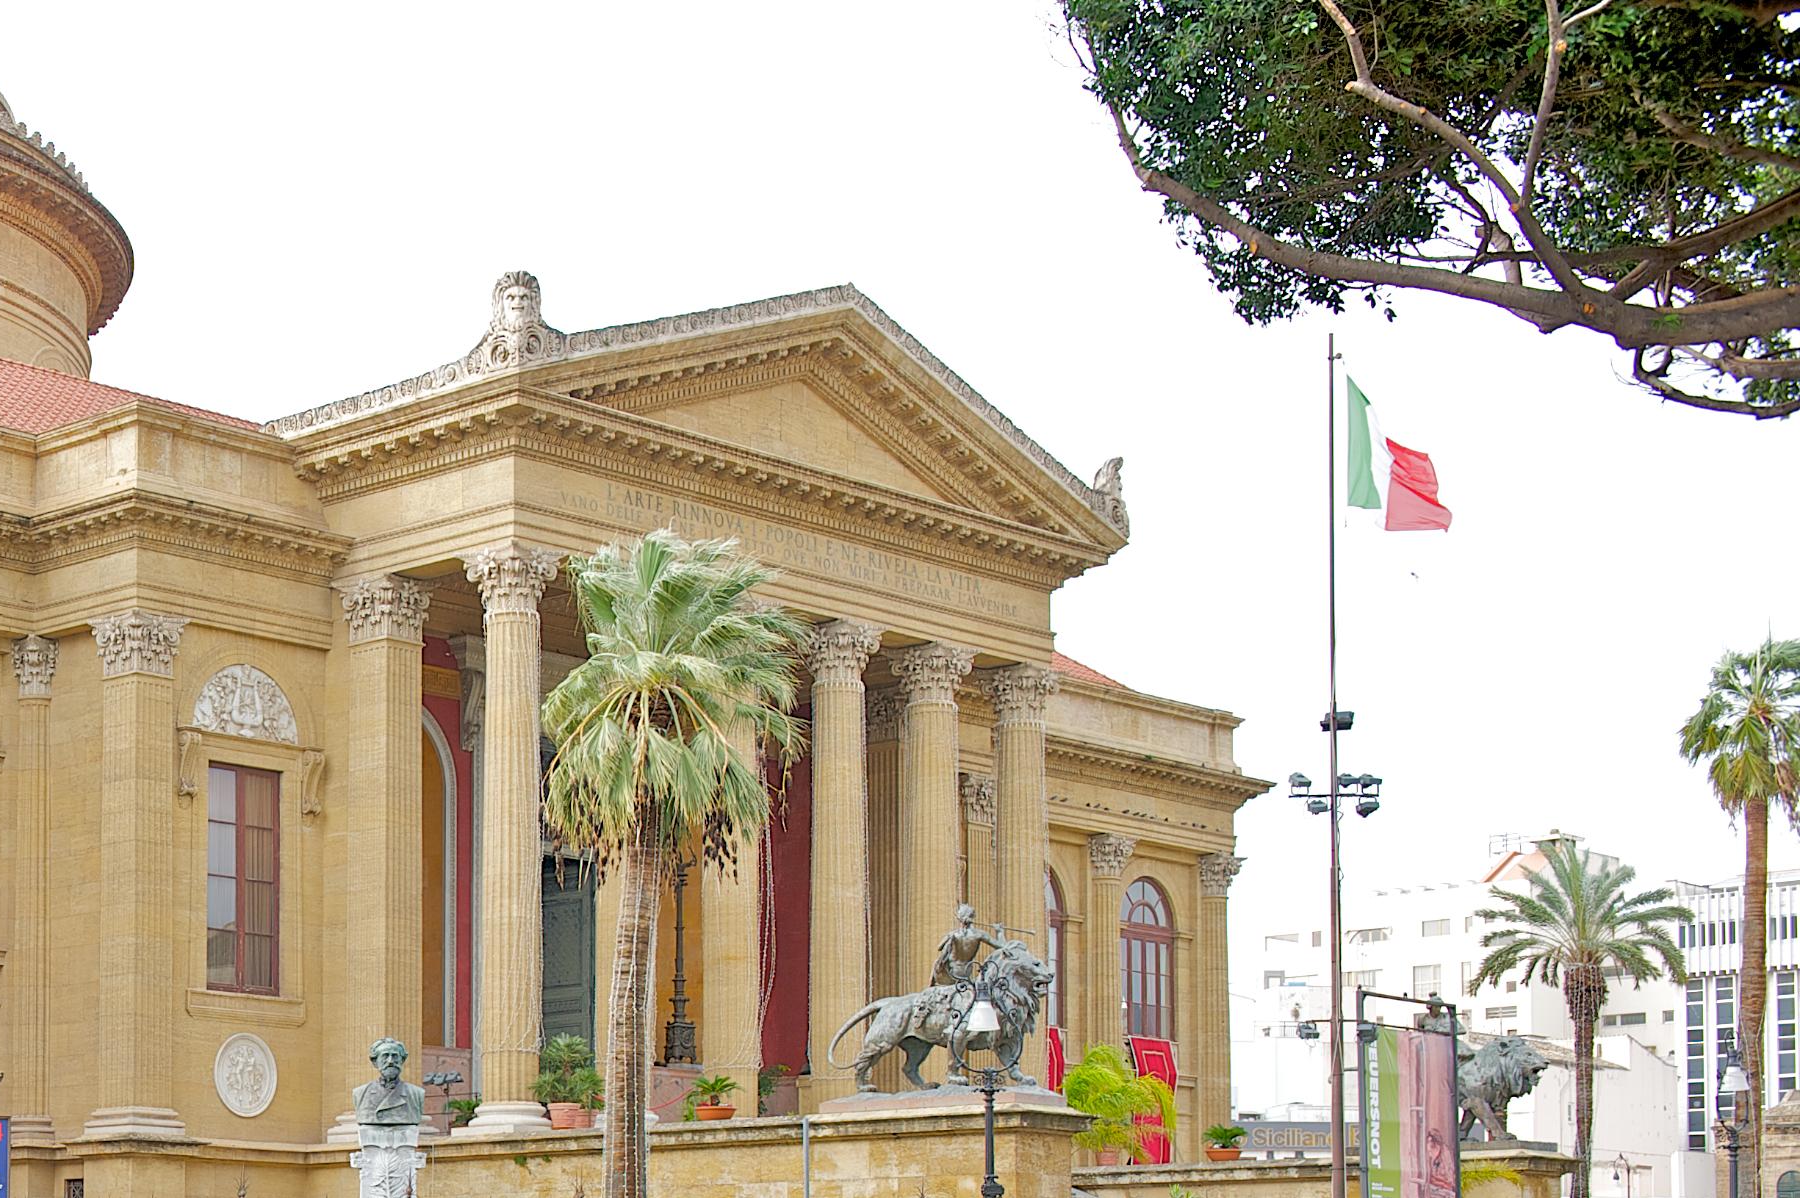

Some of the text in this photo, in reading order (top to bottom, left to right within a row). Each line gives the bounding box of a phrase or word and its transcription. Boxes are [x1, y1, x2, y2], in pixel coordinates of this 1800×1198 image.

[560, 491, 599, 512] VANO
[606, 502, 643, 524] DELLE
[783, 548, 808, 566] OVE
[814, 555, 840, 573] NON
[672, 500, 747, 534] RINNOVA
[751, 520, 757, 537] I
[766, 524, 817, 553] POPOLI
[826, 540, 834, 556] E
[841, 543, 858, 564] NE
[868, 551, 919, 579] RIVELA
[927, 566, 942, 585] LA
[950, 573, 983, 595] VITA
